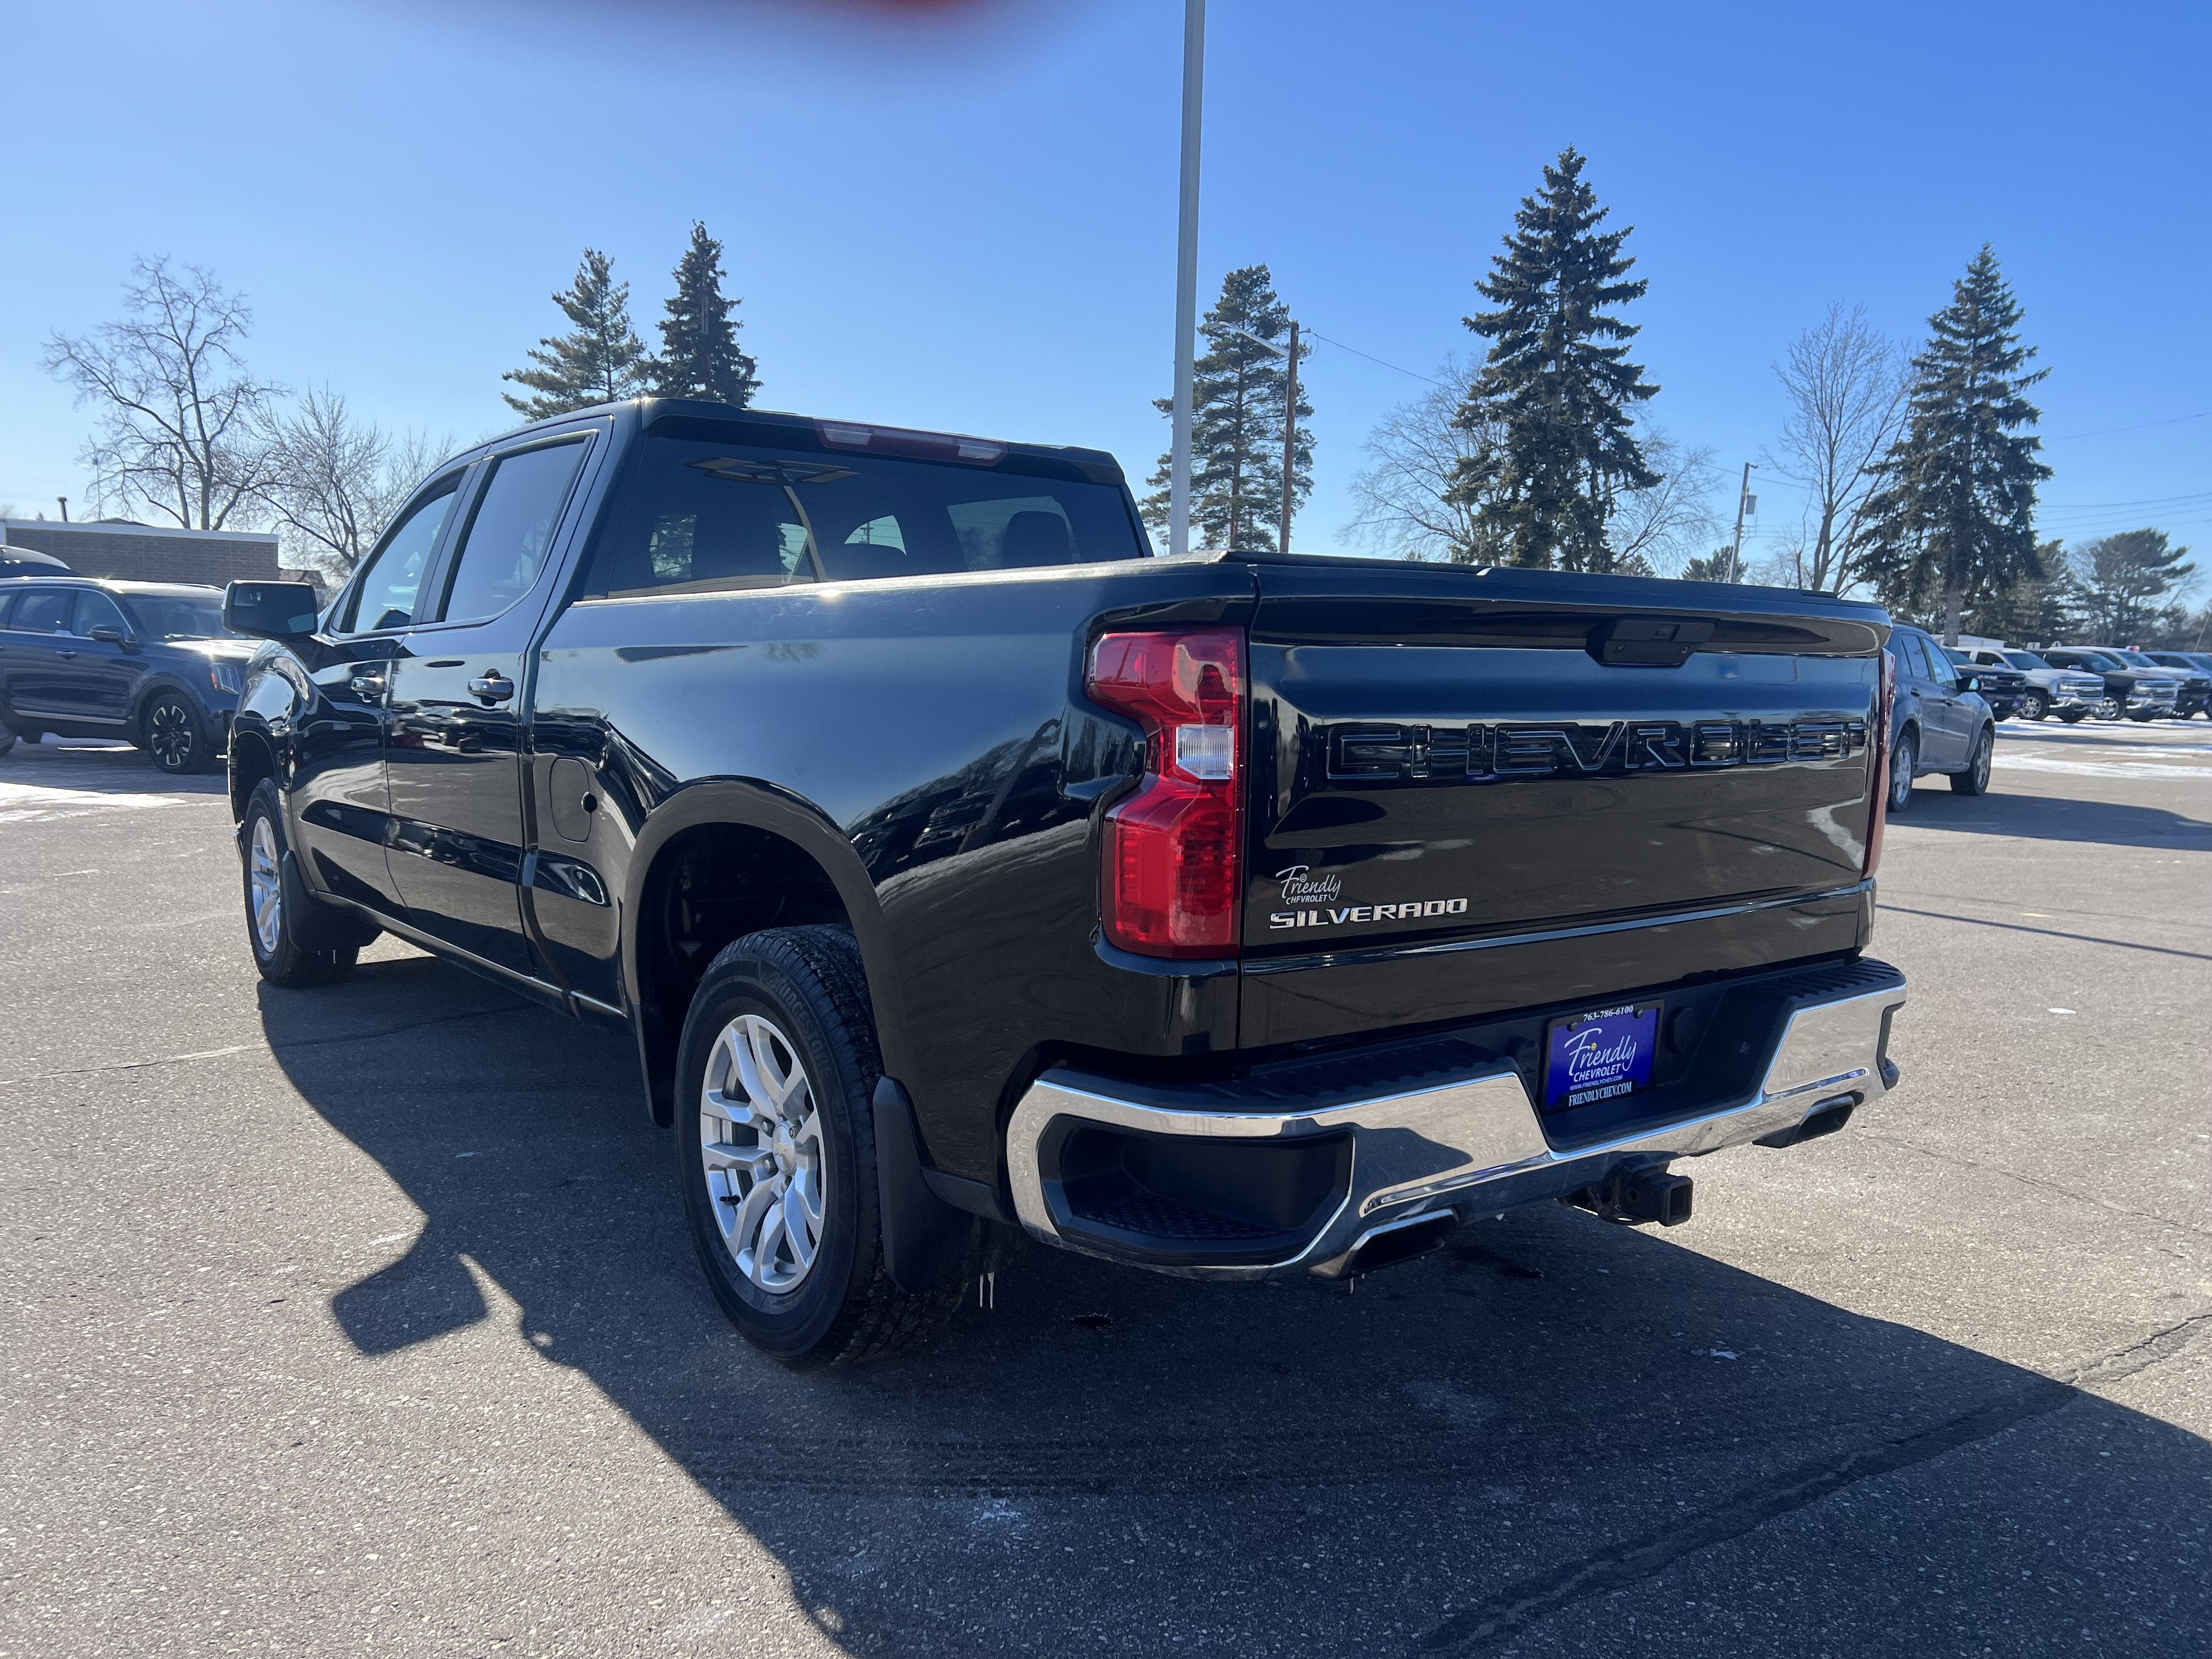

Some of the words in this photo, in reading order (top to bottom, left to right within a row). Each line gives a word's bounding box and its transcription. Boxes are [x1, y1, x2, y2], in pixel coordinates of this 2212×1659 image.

[1325, 717, 1865, 780] CHEVROLET
[1276, 865, 1341, 901] Friendly
[1269, 898, 1468, 929] SILVERADO
[1583, 1005, 1634, 1022] 763-786-6100
[1564, 1027, 1637, 1076] Friendly
[1570, 1074, 1623, 1091] WWW.FRIENDLYCHEV.COM
[1573, 1063, 1621, 1082] CHEVROLET
[1568, 1081, 1632, 1107] FRIENDLYCHEV.COM
